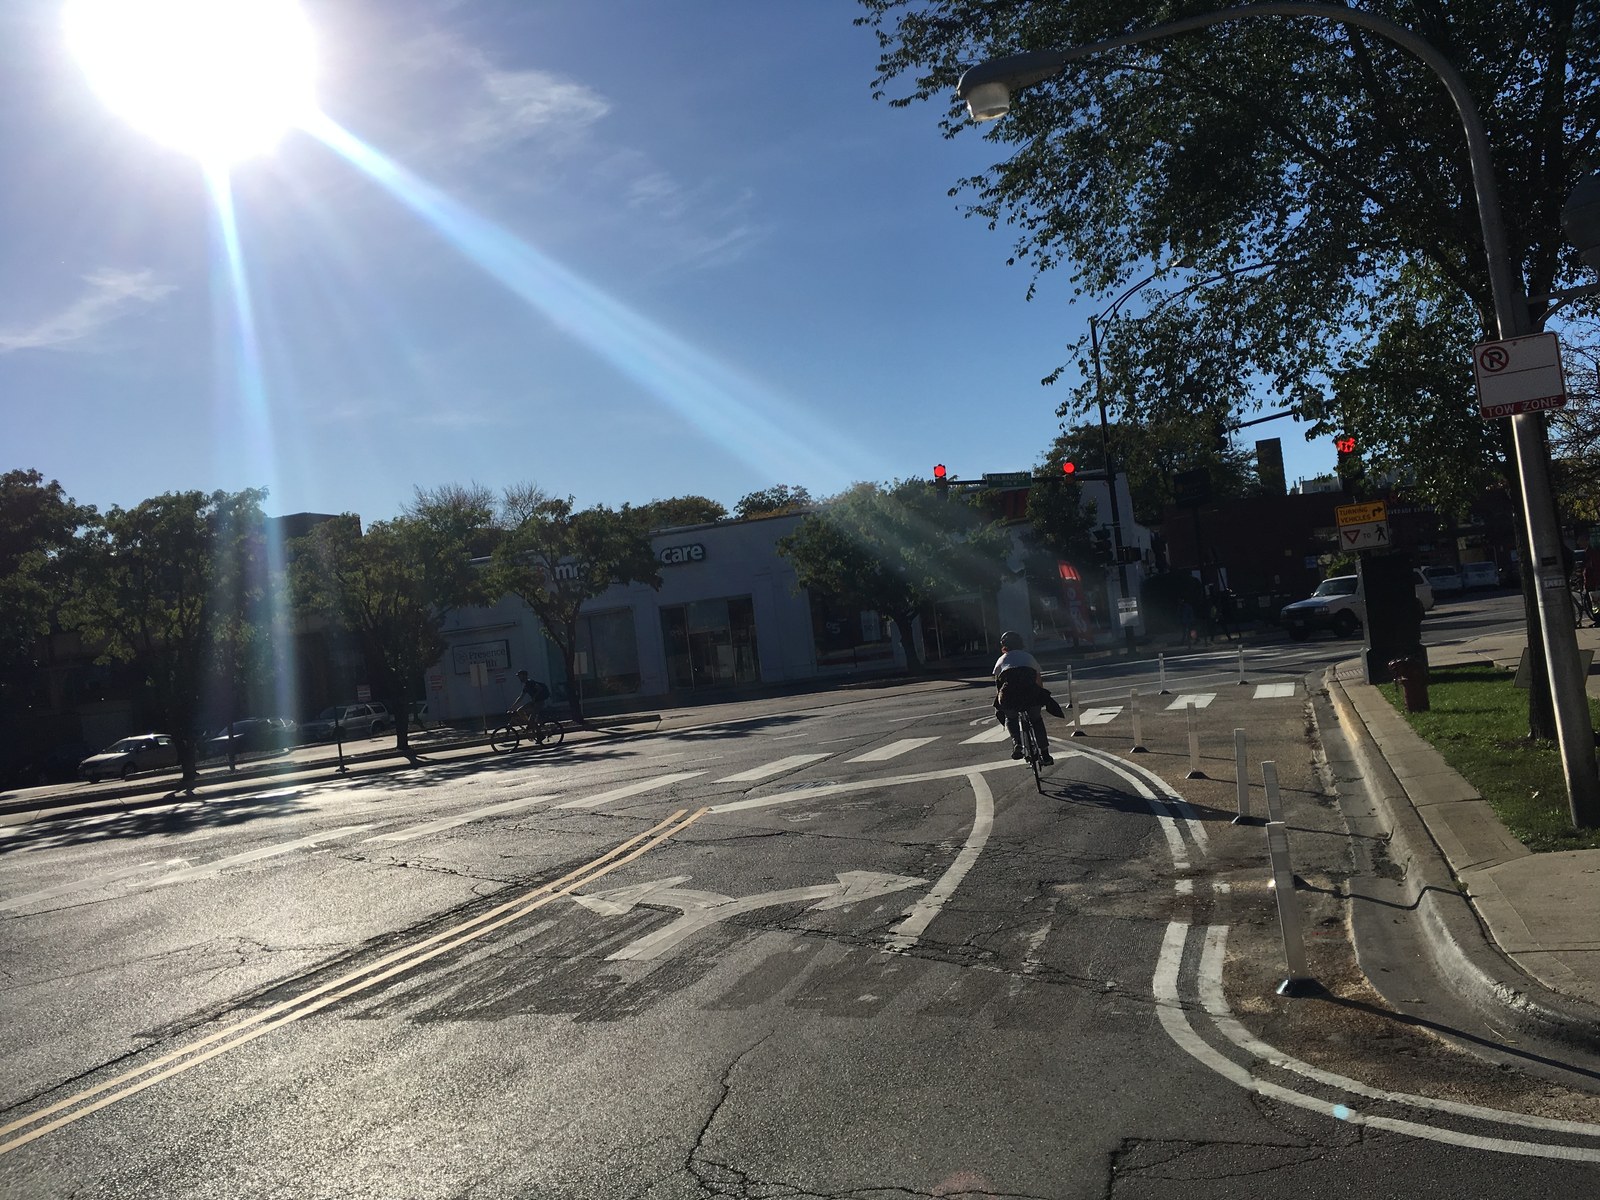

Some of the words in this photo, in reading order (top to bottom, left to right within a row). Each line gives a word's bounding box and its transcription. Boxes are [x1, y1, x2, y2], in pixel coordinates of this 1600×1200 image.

[1486, 404, 1515, 417] TOW
[1522, 396, 1559, 411] ZONE
[1338, 506, 1368, 516] TURNING
[1340, 514, 1372, 523] VEHICLES
[660, 543, 705, 565] care
